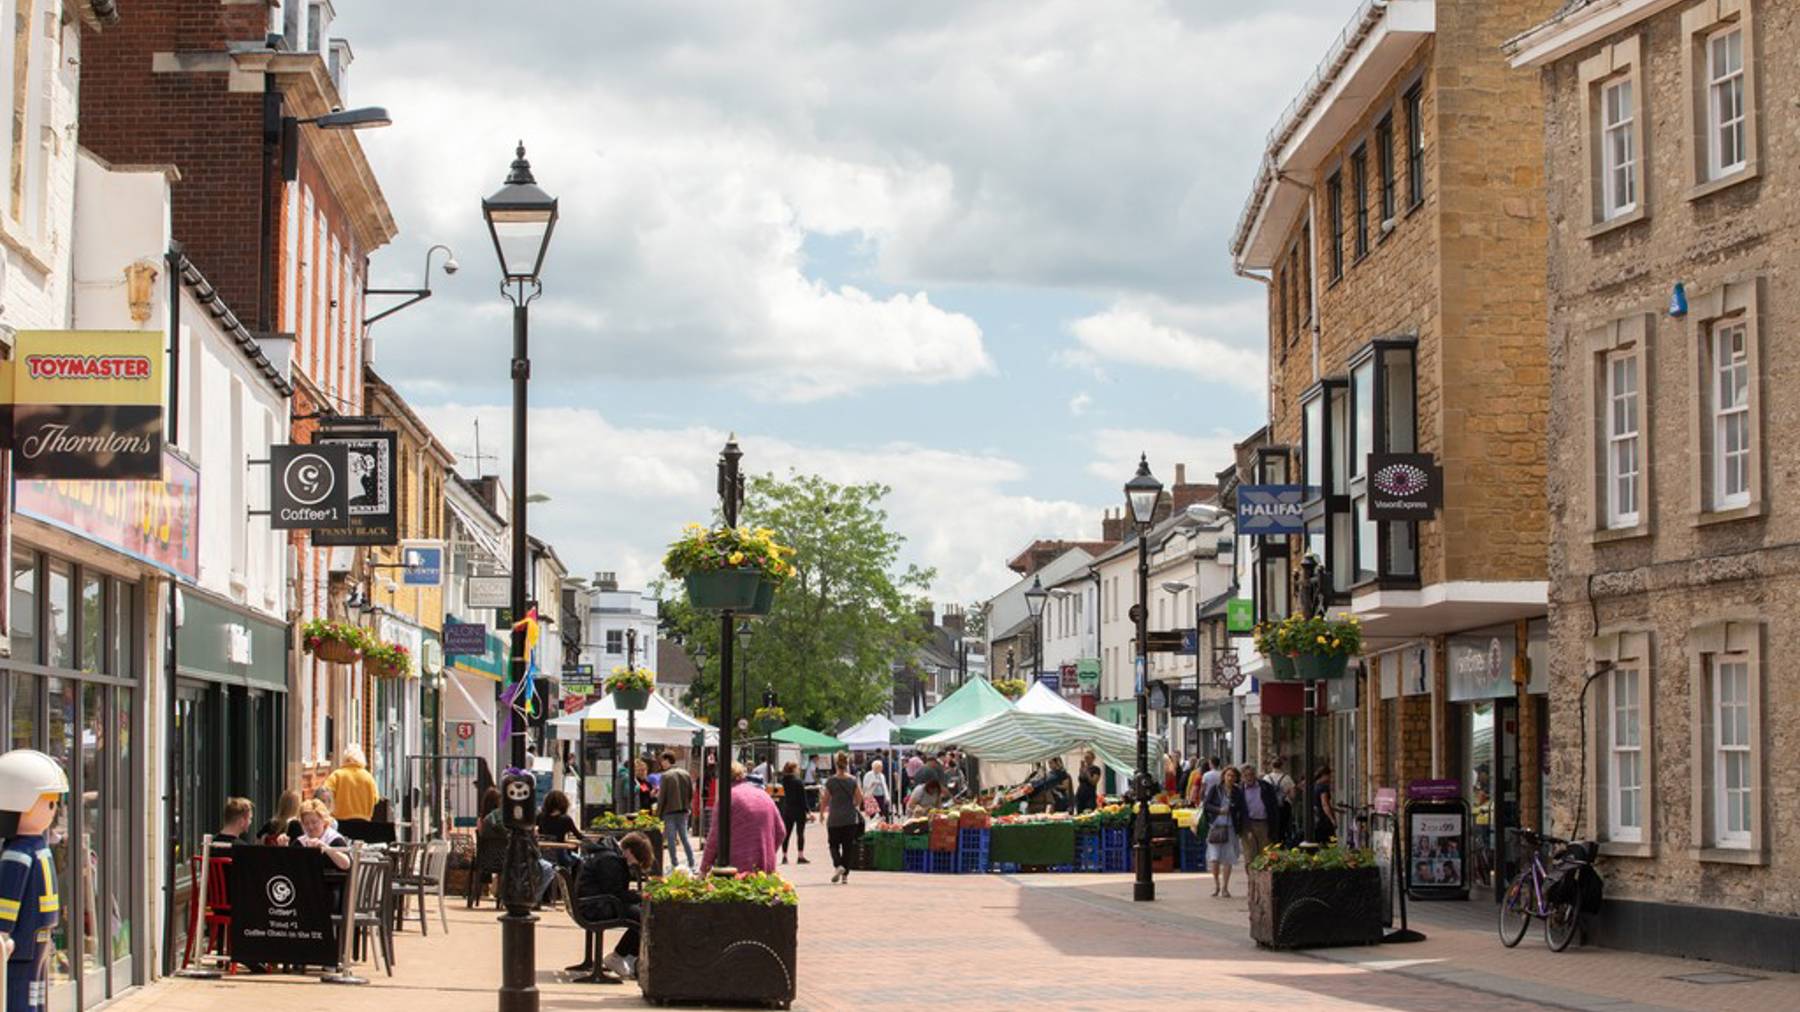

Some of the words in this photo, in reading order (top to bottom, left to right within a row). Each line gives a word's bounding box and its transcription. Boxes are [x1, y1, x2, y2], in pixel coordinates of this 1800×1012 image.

[27, 356, 151, 378] TOYMASTER
[22, 423, 151, 459] Thorntons
[356, 527, 388, 535] BLACK
